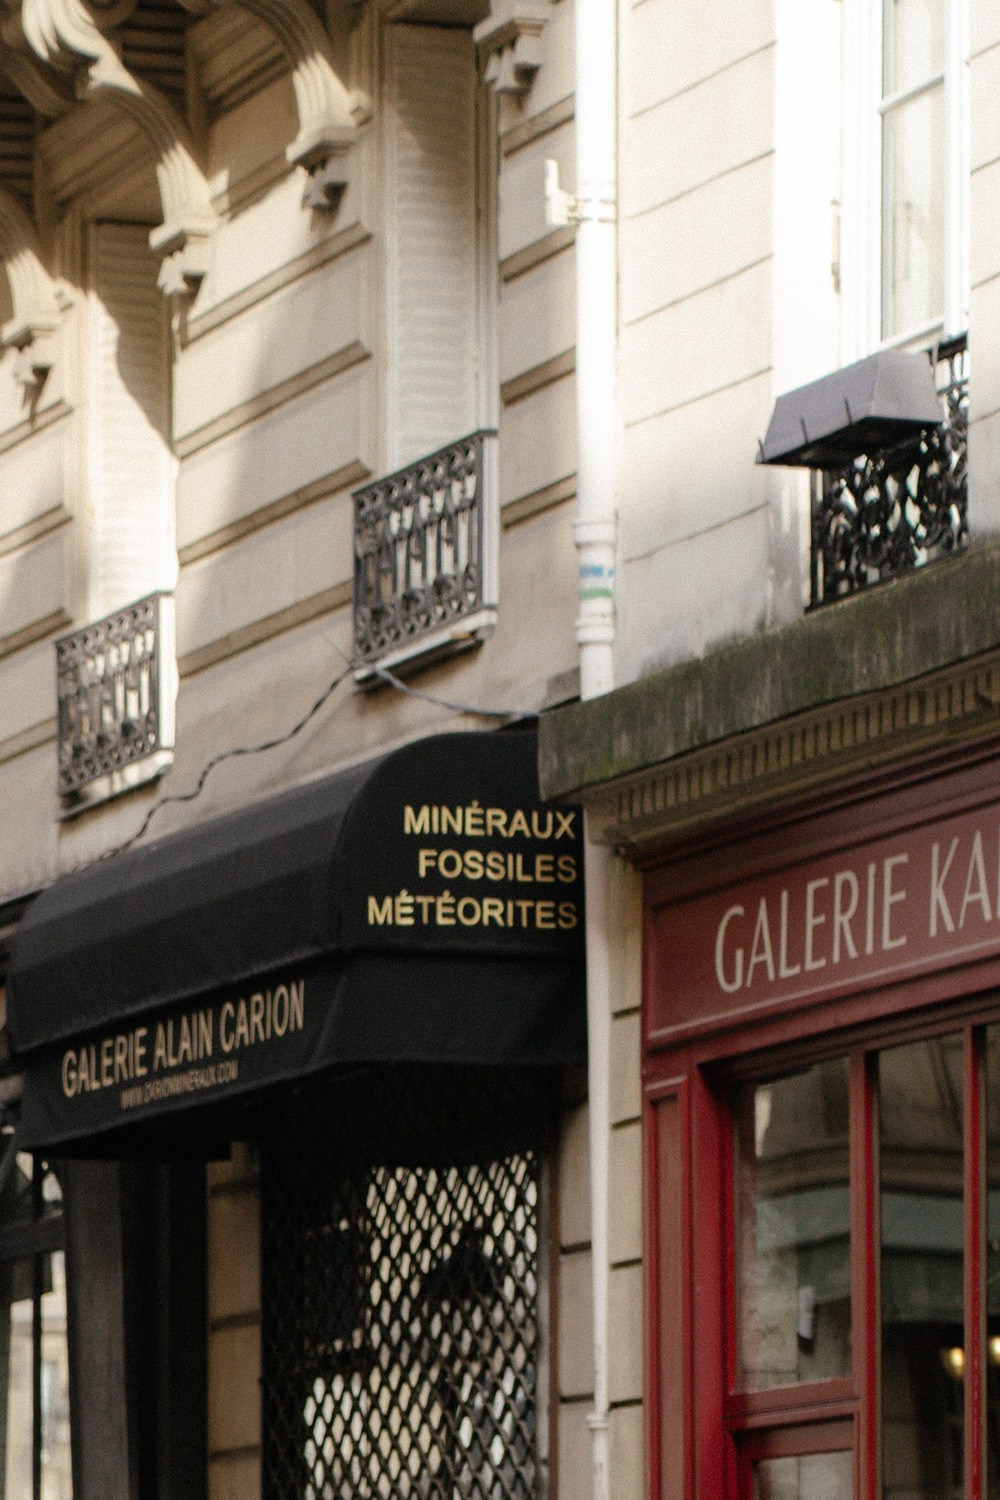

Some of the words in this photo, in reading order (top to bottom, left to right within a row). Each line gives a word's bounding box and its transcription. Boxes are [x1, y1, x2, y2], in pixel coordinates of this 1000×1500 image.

[403, 800, 577, 840] MINÉRAUX
[418, 848, 578, 884] FOSSILES
[367, 889, 578, 930] MÉTÉORITES
[714, 853, 910, 994] GALERIE
[928, 824, 1000, 938] KA
[61, 1026, 149, 1099] GALERIE
[153, 1008, 214, 1072] ALAIN
[219, 980, 306, 1054] CARION
